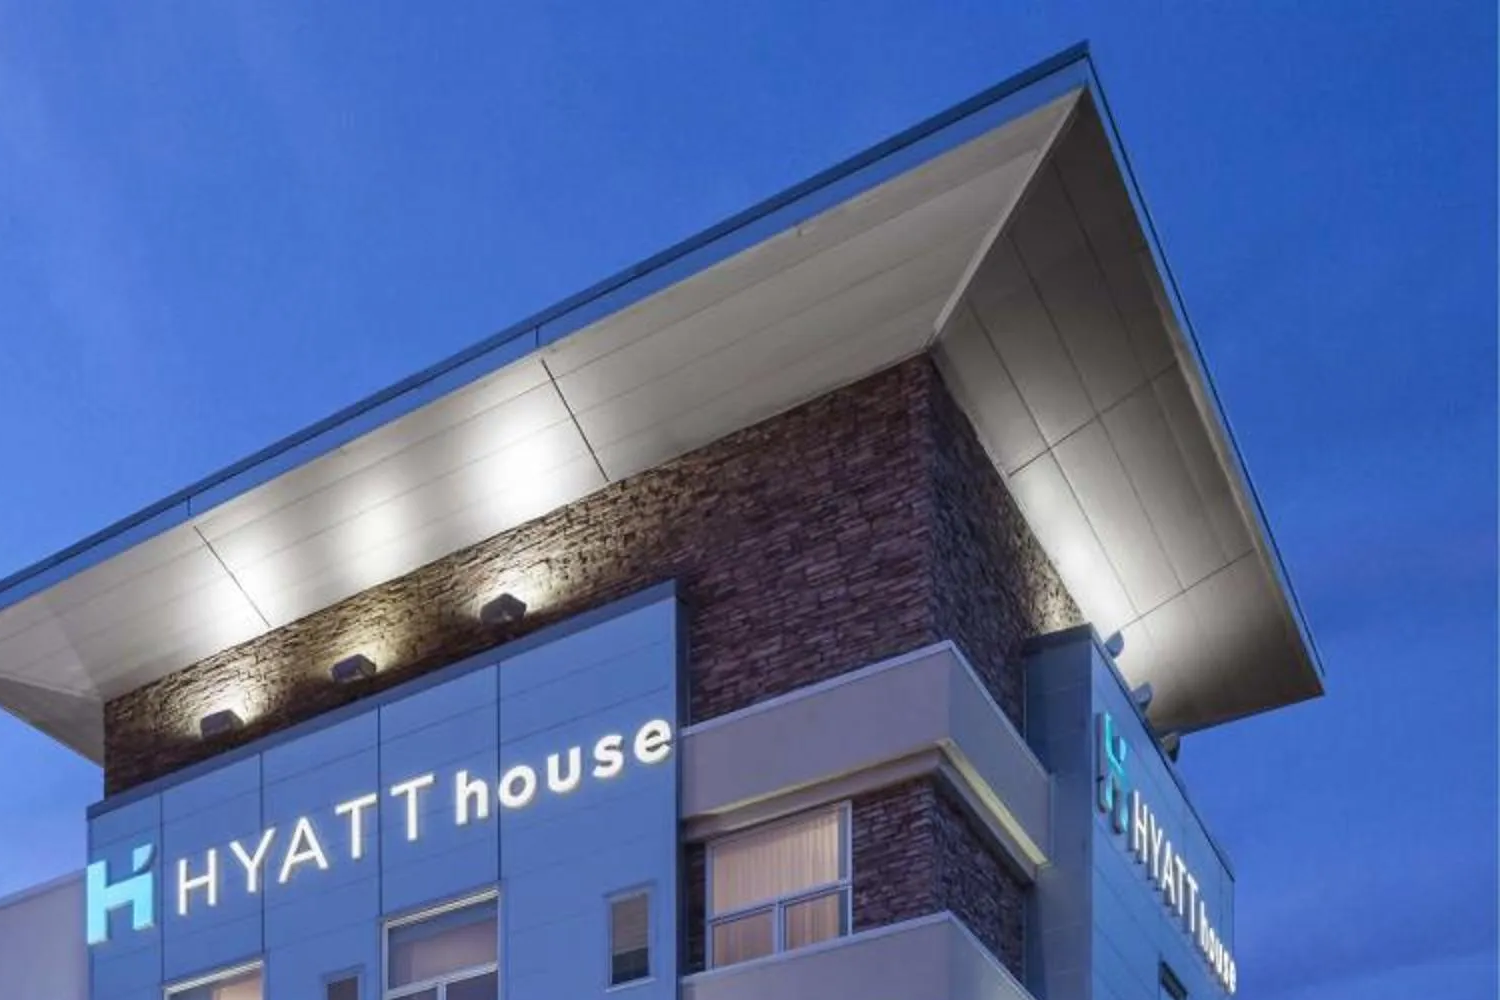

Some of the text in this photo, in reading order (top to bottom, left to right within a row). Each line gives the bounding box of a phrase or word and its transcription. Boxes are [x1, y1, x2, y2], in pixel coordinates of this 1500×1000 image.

[176, 775, 435, 915] HYATT
[454, 718, 673, 825] house
[1133, 790, 1198, 932] HYATT
